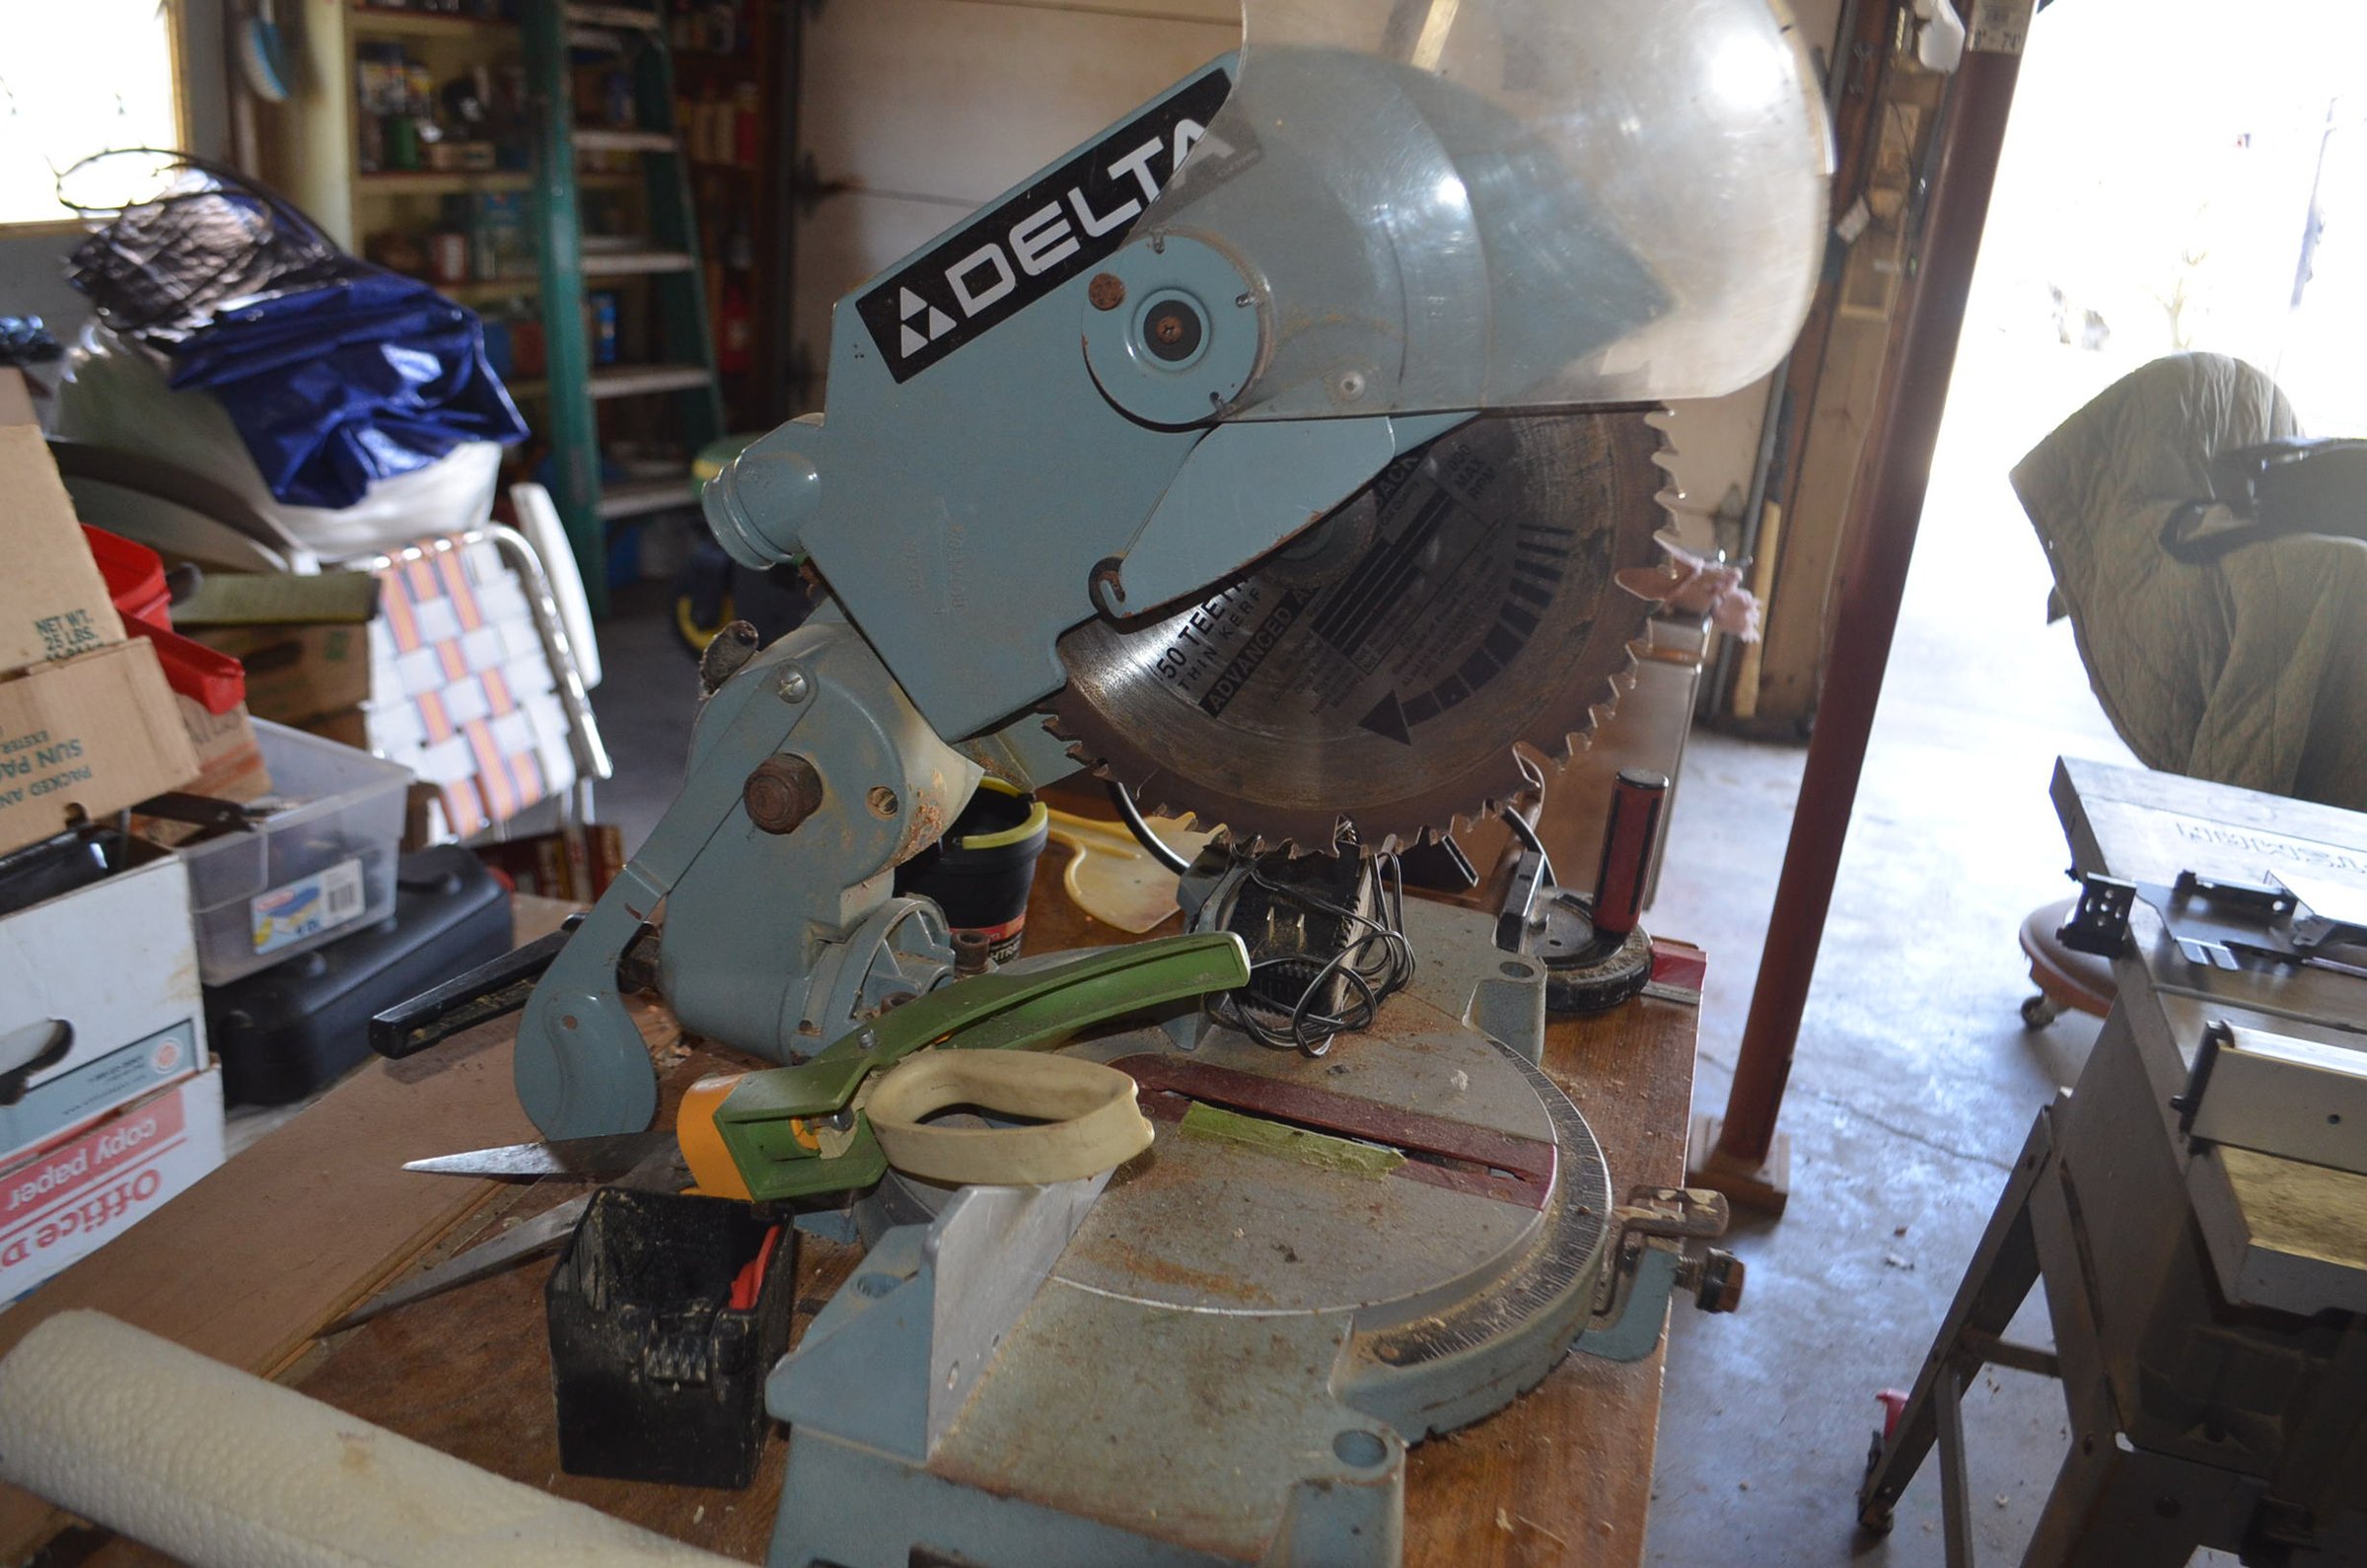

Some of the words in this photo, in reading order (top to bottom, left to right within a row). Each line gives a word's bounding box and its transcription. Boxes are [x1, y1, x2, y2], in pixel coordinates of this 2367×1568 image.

[944, 117, 1235, 319] DELTA
[34, 615, 63, 635] NET
[1179, 647, 1218, 690] THIN
[1219, 587, 1261, 639] KERF
[1157, 647, 1186, 679] 50
[1209, 605, 1293, 712] ADVANCED
[36, 739, 83, 767] SUN
[30, 766, 92, 796] PACKED
[94, 1118, 157, 1164] copy
[6, 1148, 89, 1211] paper
[36, 1169, 161, 1248] Office
